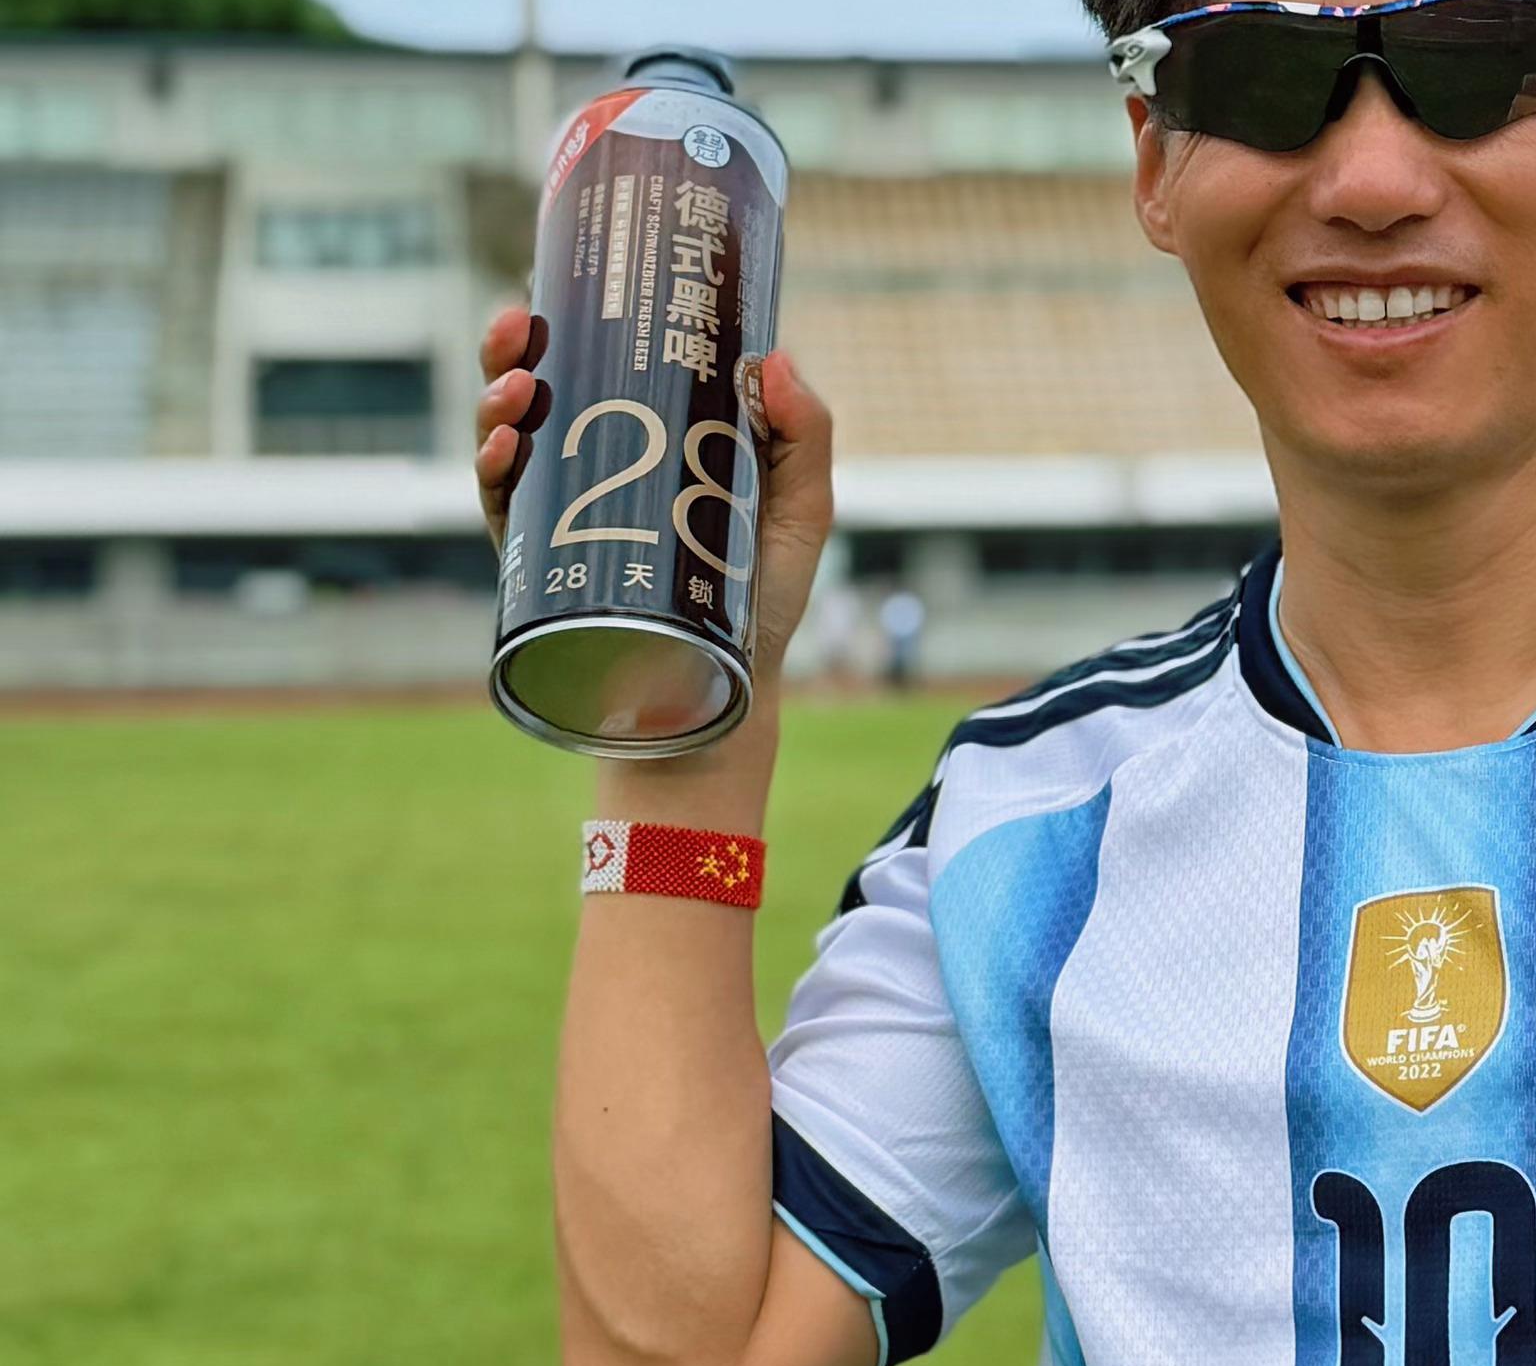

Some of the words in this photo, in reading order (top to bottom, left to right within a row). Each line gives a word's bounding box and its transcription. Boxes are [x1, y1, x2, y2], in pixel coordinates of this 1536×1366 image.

[662, 180, 731, 384] 德式黑啤
[549, 398, 757, 582] 28
[544, 562, 588, 595] 28
[622, 563, 654, 590] 天
[1387, 1024, 1459, 1054] FIFA
[1367, 1055, 1407, 1067] WORLD
[1409, 1048, 1475, 1063] CHAMPIONS
[1398, 1063, 1442, 1081] 2022
